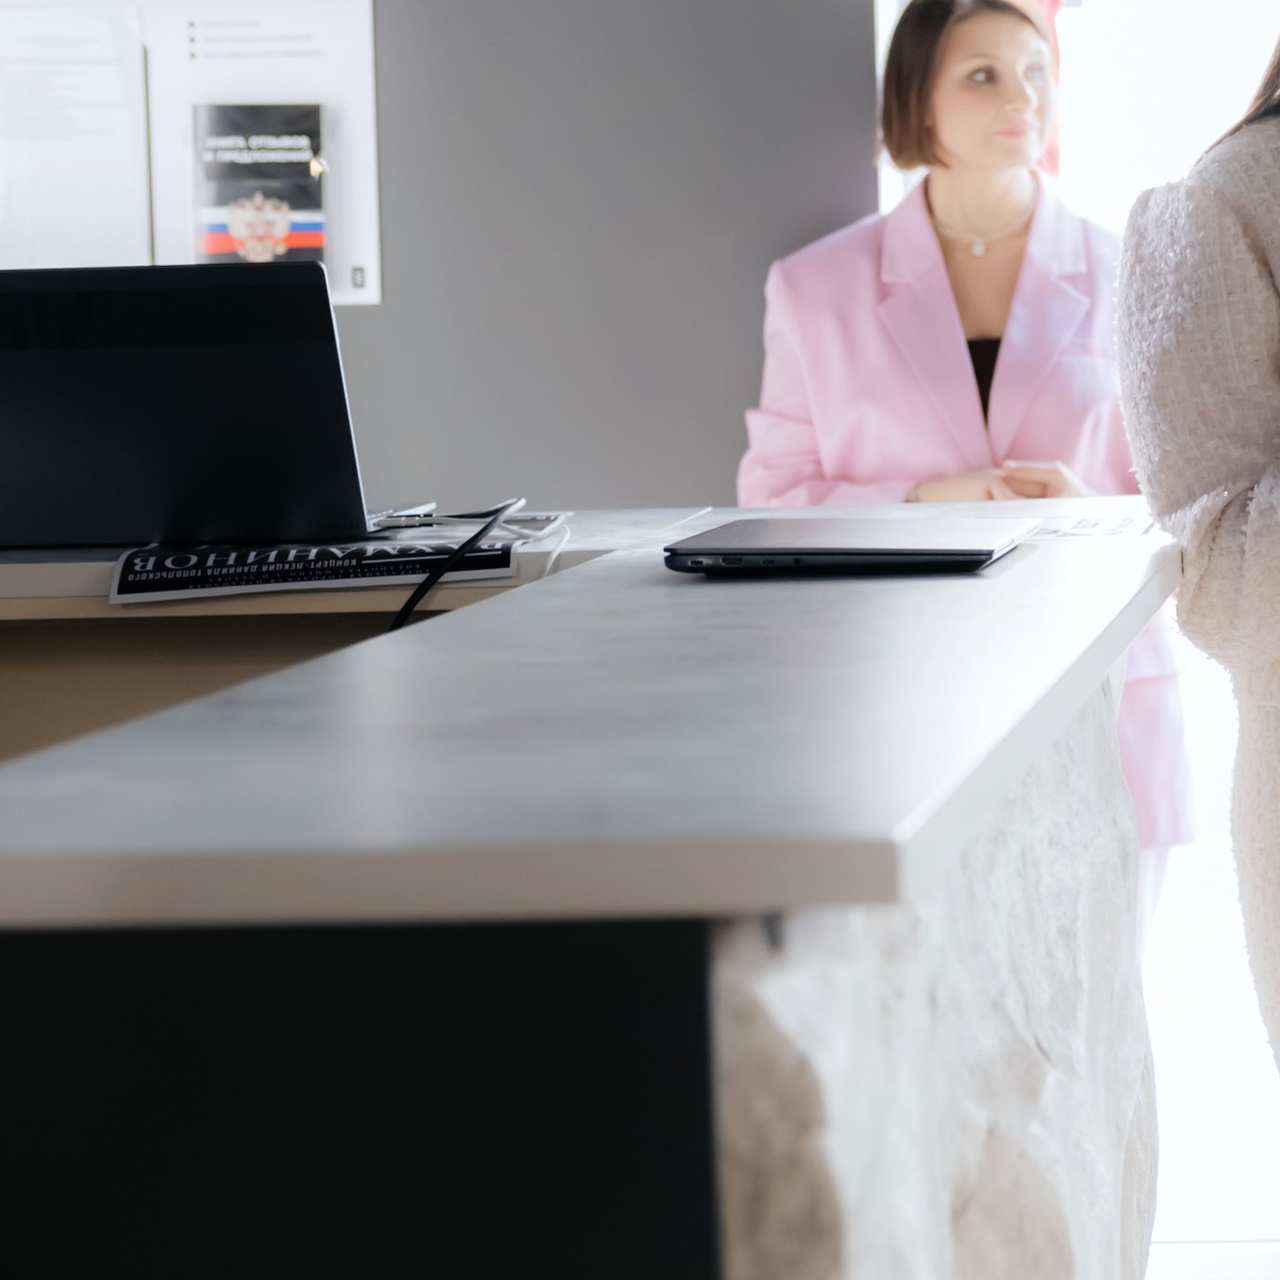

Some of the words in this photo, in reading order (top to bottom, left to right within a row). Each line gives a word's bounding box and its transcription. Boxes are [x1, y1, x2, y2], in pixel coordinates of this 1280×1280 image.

[206, 564, 259, 576] ДАНИИЛА
[261, 558, 357, 572] КОНЦЕРТ-ЛЕКЦИЯ
[128, 568, 202, 581] ТОПОЛЬСКОГО
